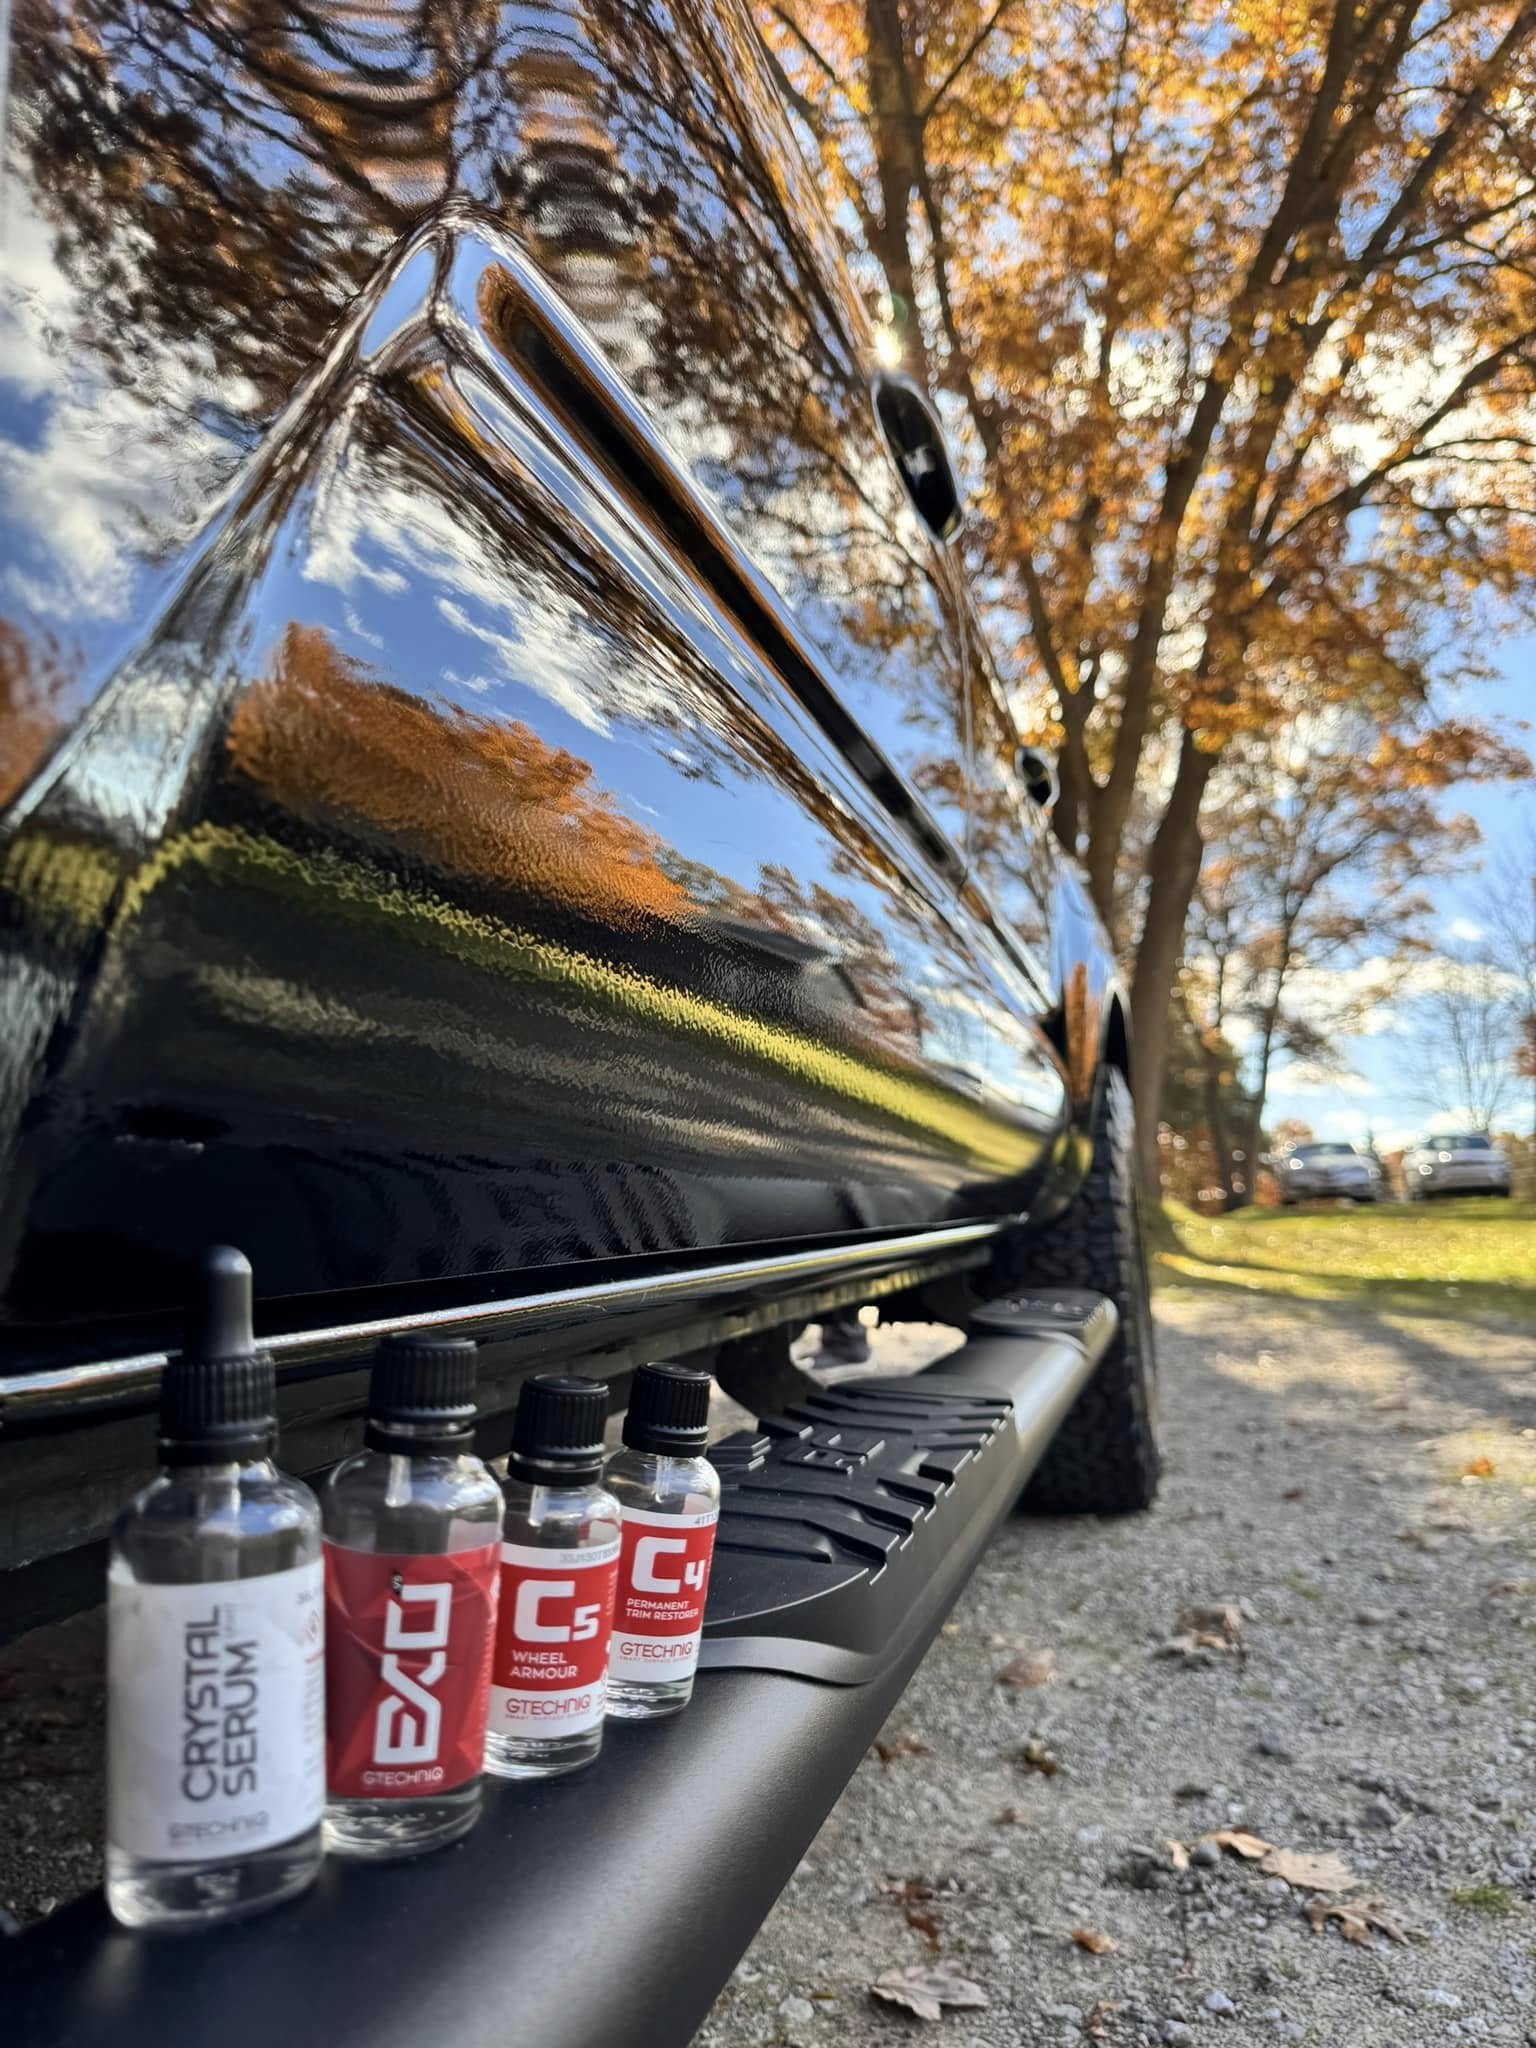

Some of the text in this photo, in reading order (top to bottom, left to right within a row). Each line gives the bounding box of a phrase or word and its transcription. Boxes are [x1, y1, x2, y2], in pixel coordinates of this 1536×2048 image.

[631, 1536, 706, 1594] C4
[513, 1579, 602, 1643] C5
[627, 1598, 690, 1610] PERMANENT
[626, 1608, 700, 1621] TRIM RESTORER
[512, 1649, 568, 1665] WHEEL
[620, 1641, 693, 1658] GTECHNIQ
[509, 1665, 578, 1680] ARMOUR
[181, 1604, 219, 1803] CRYSTAL
[506, 1694, 591, 1715] GTECHNIQ
[222, 1640, 258, 1797] SERUM
[362, 1767, 444, 1786] GTECHNIQ
